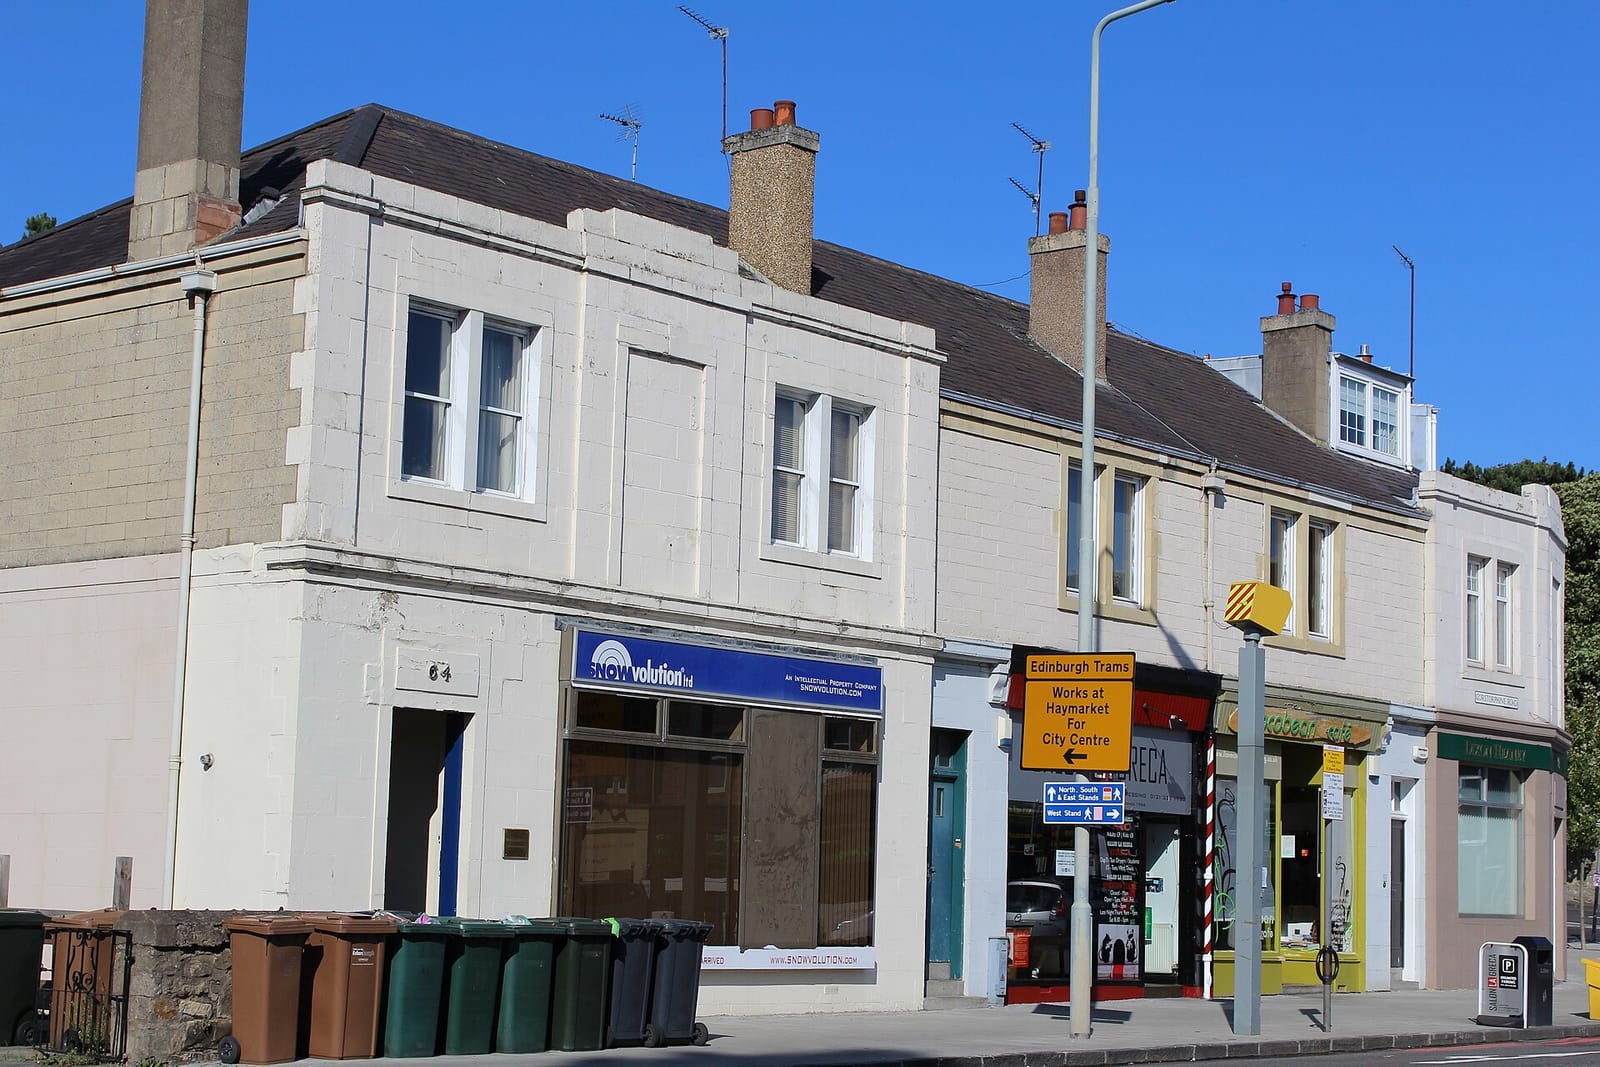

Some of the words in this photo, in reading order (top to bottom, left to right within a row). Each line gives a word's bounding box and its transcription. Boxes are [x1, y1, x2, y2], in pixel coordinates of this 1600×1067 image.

[428, 663, 452, 683] 64
[1031, 660, 1089, 675] Edinburgh
[1094, 660, 1129, 673] Trams
[800, 684, 862, 698] SNOWVOLUTION.COM
[1052, 687, 1088, 699] Works
[1092, 687, 1105, 699] at
[1046, 702, 1109, 716] Haymarket
[1067, 718, 1086, 730] For
[1264, 710, 1317, 738] cobean
[1042, 733, 1066, 747] City
[1070, 733, 1110, 746] Centre
[1119, 746, 1168, 785] RECA
[1080, 786, 1098, 794] South
[1488, 978, 1498, 987] LA
